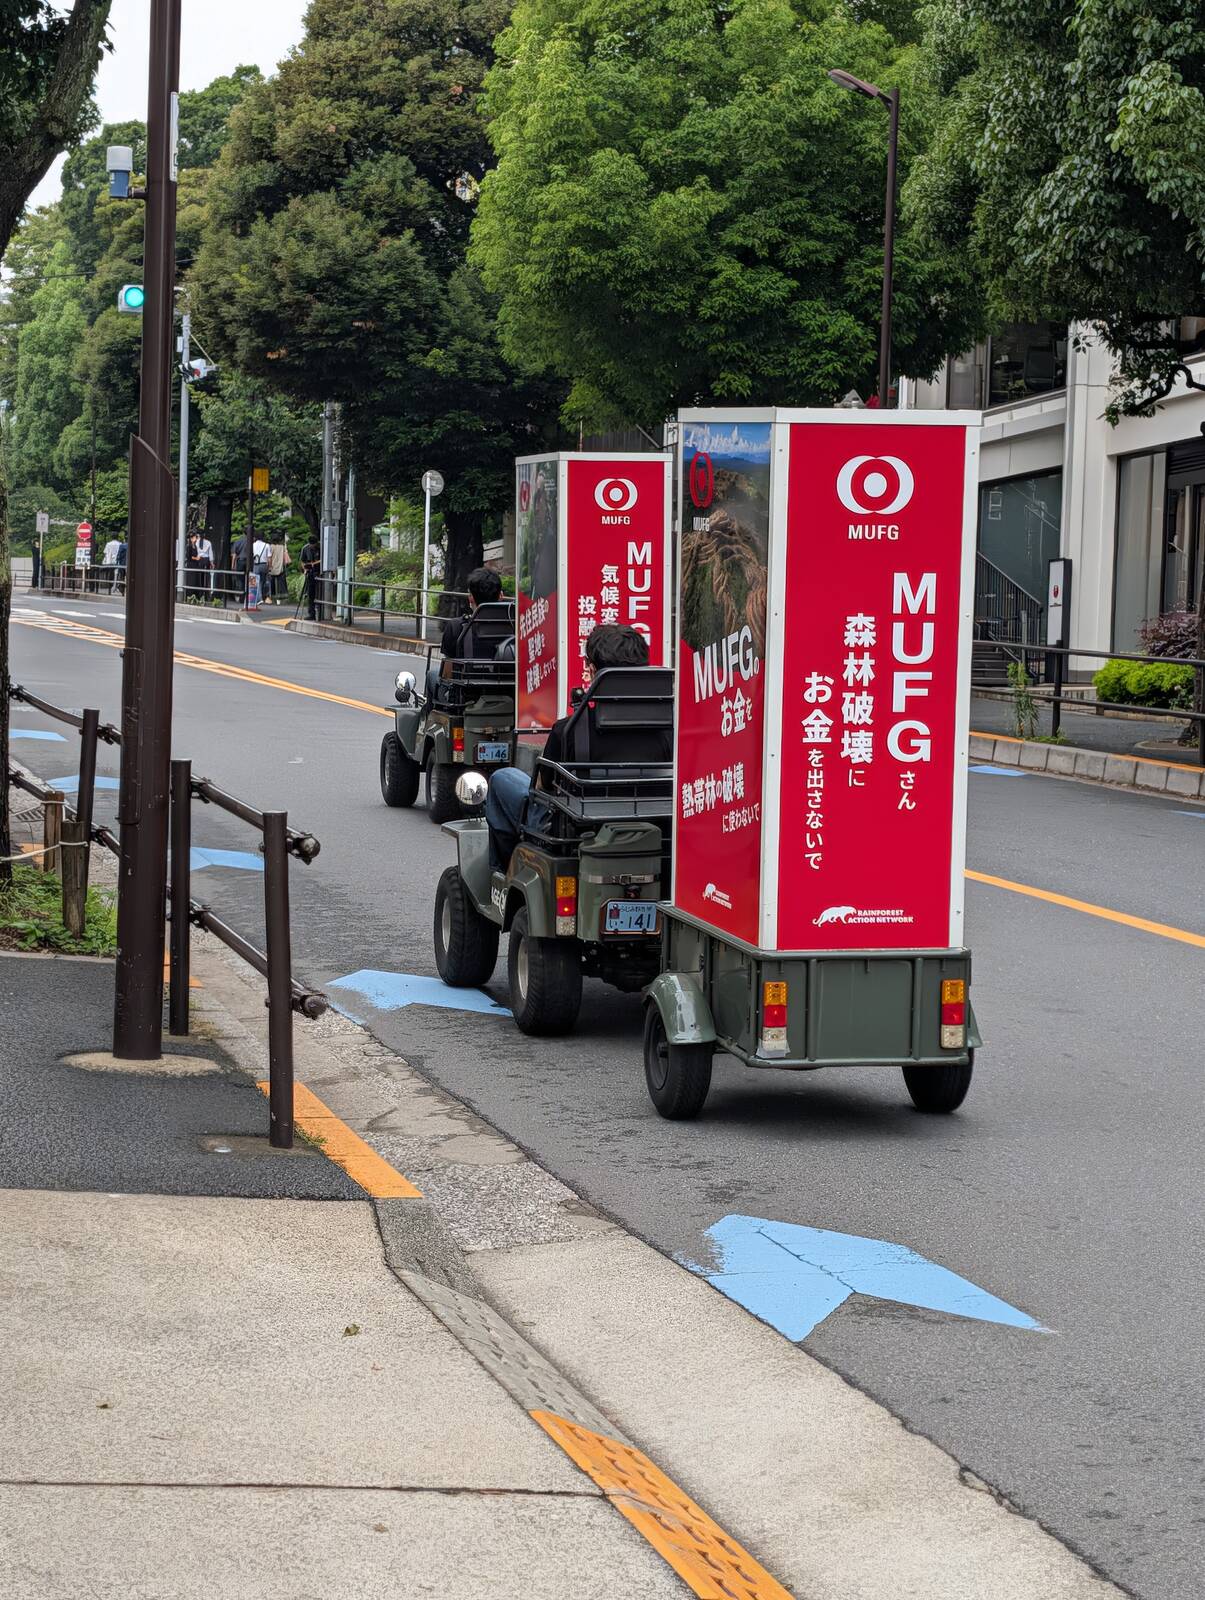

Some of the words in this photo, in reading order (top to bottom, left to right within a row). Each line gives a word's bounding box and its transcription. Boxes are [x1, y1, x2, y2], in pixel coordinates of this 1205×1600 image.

[601, 515, 631, 526] MUFG
[692, 516, 710, 532] MUFG
[848, 524, 900, 541] MUFG
[840, 612, 877, 787] 森林破壊に
[886, 572, 937, 811] MUFGさん
[720, 687, 753, 737] お金を
[681, 762, 745, 819] 熱帯林の破壊
[800, 671, 835, 871] お金を出さないで
[722, 803, 761, 834] に使わないで
[847, 916, 876, 924] ACTION
[876, 916, 914, 924] NETWORK
